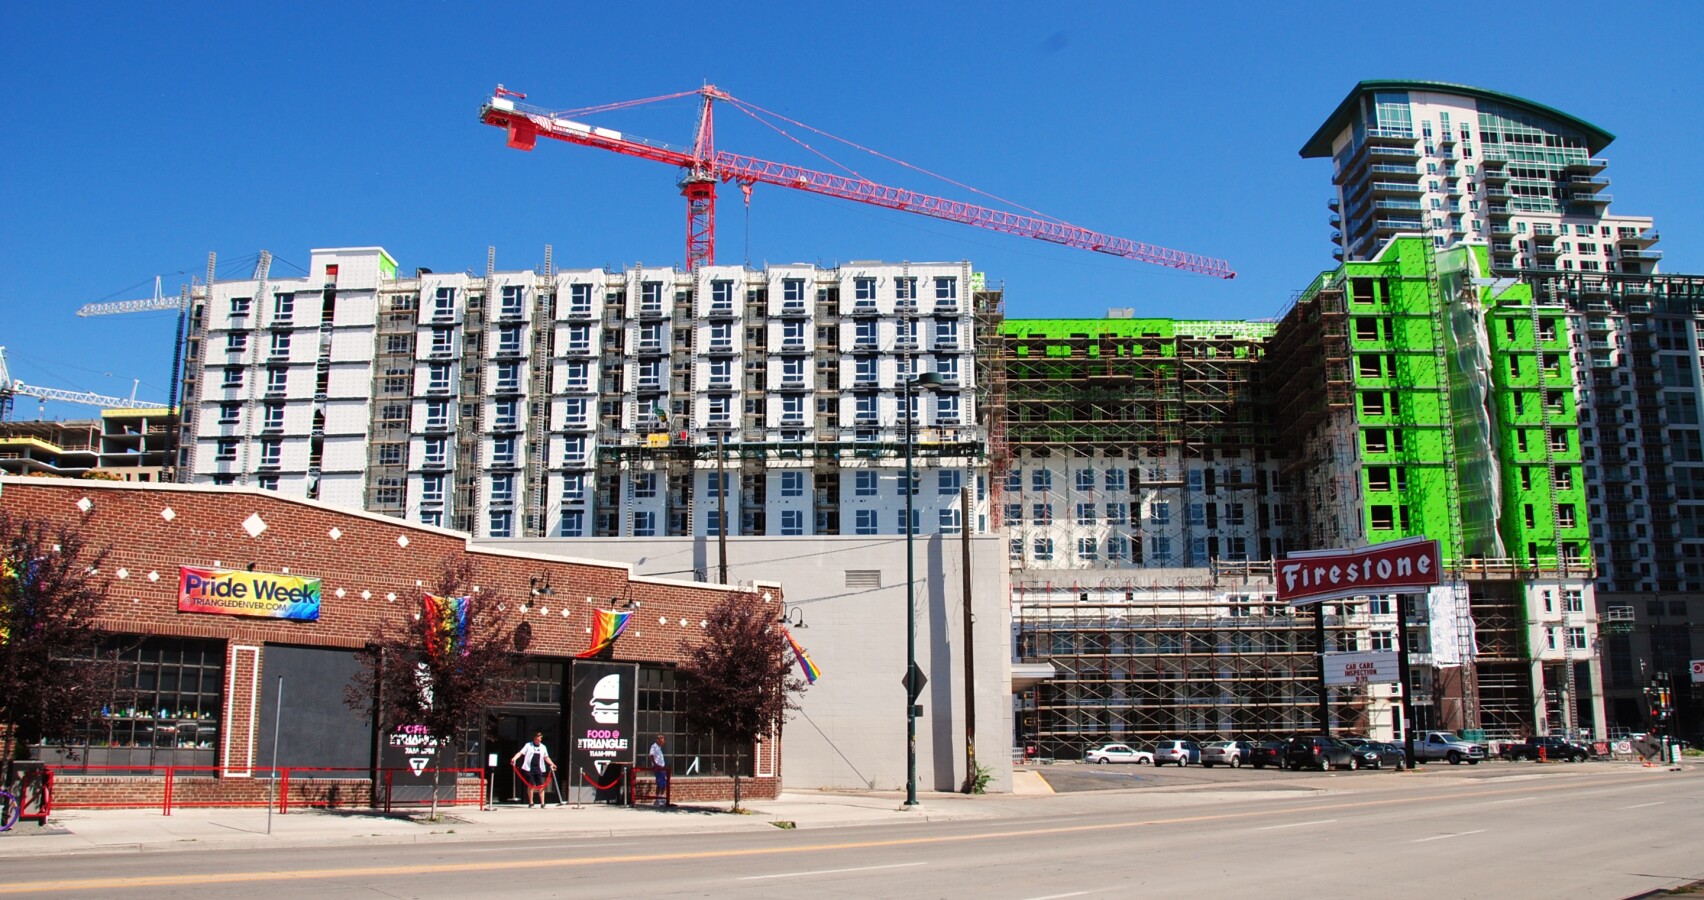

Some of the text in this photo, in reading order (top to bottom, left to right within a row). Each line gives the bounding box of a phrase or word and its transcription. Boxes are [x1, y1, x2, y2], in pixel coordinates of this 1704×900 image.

[1281, 554, 1431, 592] Firestone
[185, 574, 316, 604] Pride Week
[582, 738, 624, 749] TRIANGLE
[587, 730, 611, 739] FOOD
